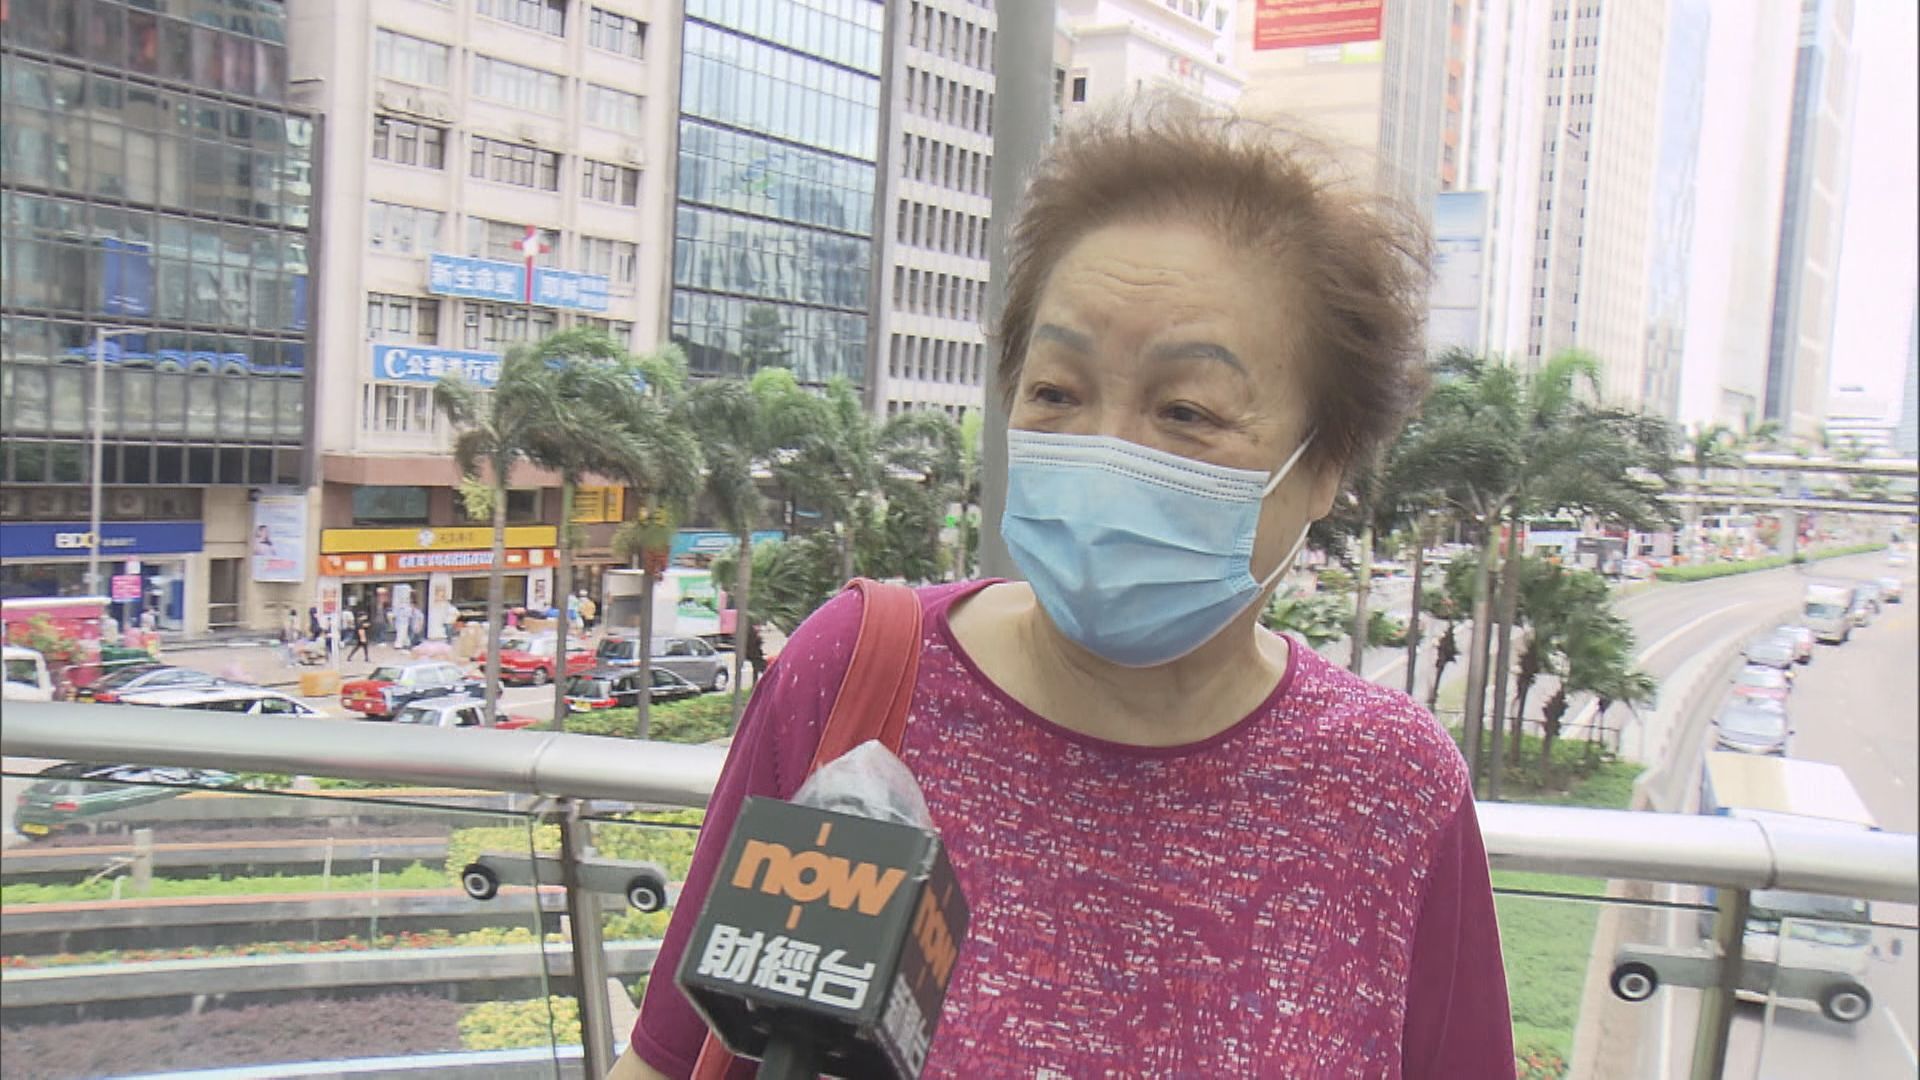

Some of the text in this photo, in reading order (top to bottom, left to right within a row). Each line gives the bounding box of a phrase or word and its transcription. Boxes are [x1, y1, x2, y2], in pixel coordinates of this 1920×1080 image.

[732, 839, 906, 916] now
[697, 923, 877, 1010] 財經台
